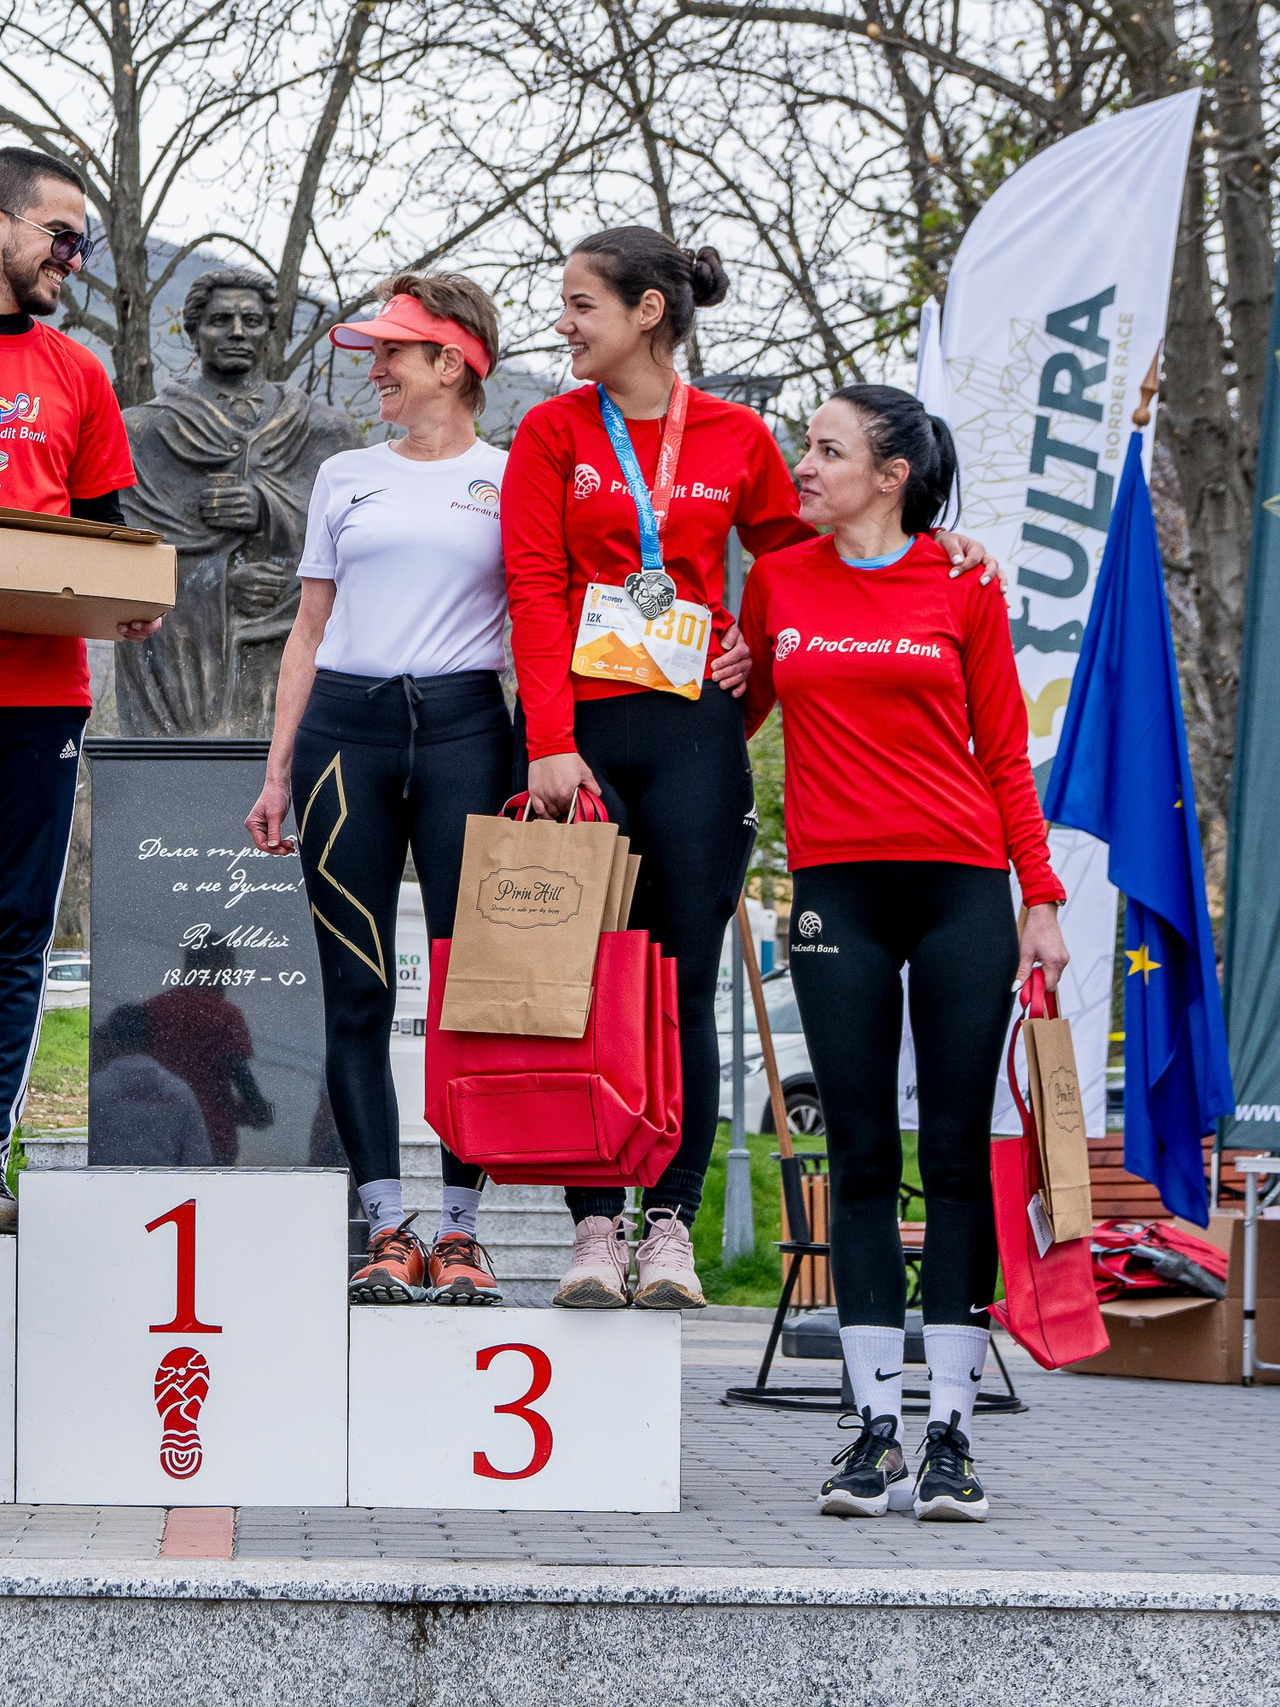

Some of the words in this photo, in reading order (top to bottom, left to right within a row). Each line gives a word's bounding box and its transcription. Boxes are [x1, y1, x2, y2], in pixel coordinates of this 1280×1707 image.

[1114, 312, 1133, 367] RACE
[1105, 374, 1128, 460] BORDER
[19, 426, 47, 443] Bank
[1018, 284, 1116, 599] ULTRA
[691, 482, 731, 503] Bank
[450, 501, 491, 517] ProCredit
[586, 612, 602, 623] 12K
[806, 636, 892, 654] ProCredit
[895, 638, 941, 659] Bank
[139, 837, 199, 861] Дела
[172, 881, 188, 892] а
[195, 881, 222, 892] не
[494, 879, 532, 901] Pirin
[791, 944, 816, 952] ProCredit
[817, 944, 839, 953] Bank
[161, 968, 257, 986] 18.07.1837
[144, 1198, 223, 1334] 1
[472, 1343, 553, 1479] 3
